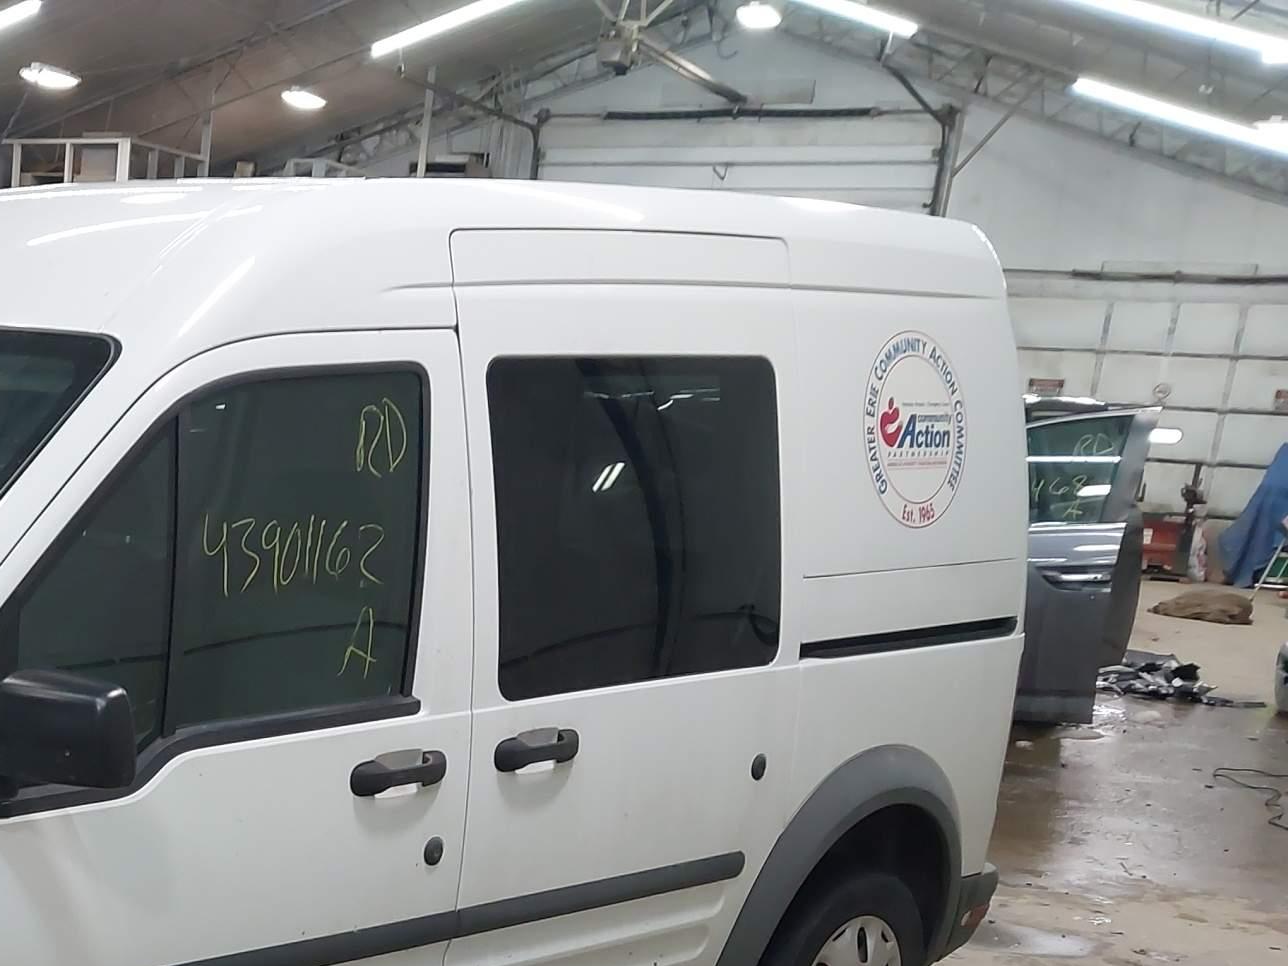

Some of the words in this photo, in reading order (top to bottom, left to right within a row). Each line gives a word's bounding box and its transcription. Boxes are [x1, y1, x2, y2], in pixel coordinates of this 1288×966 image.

[874, 337, 928, 381] COMMUNITY
[929, 346, 958, 396] ACTION
[865, 384, 880, 418] ERIE
[896, 413, 951, 448] Action
[947, 400, 965, 492] COMMITTEE
[866, 426, 888, 495] GREATER
[901, 503, 917, 523] Est.
[918, 502, 936, 524] 1965
[203, 514, 385, 597] 43901162
[337, 606, 377, 680] A
